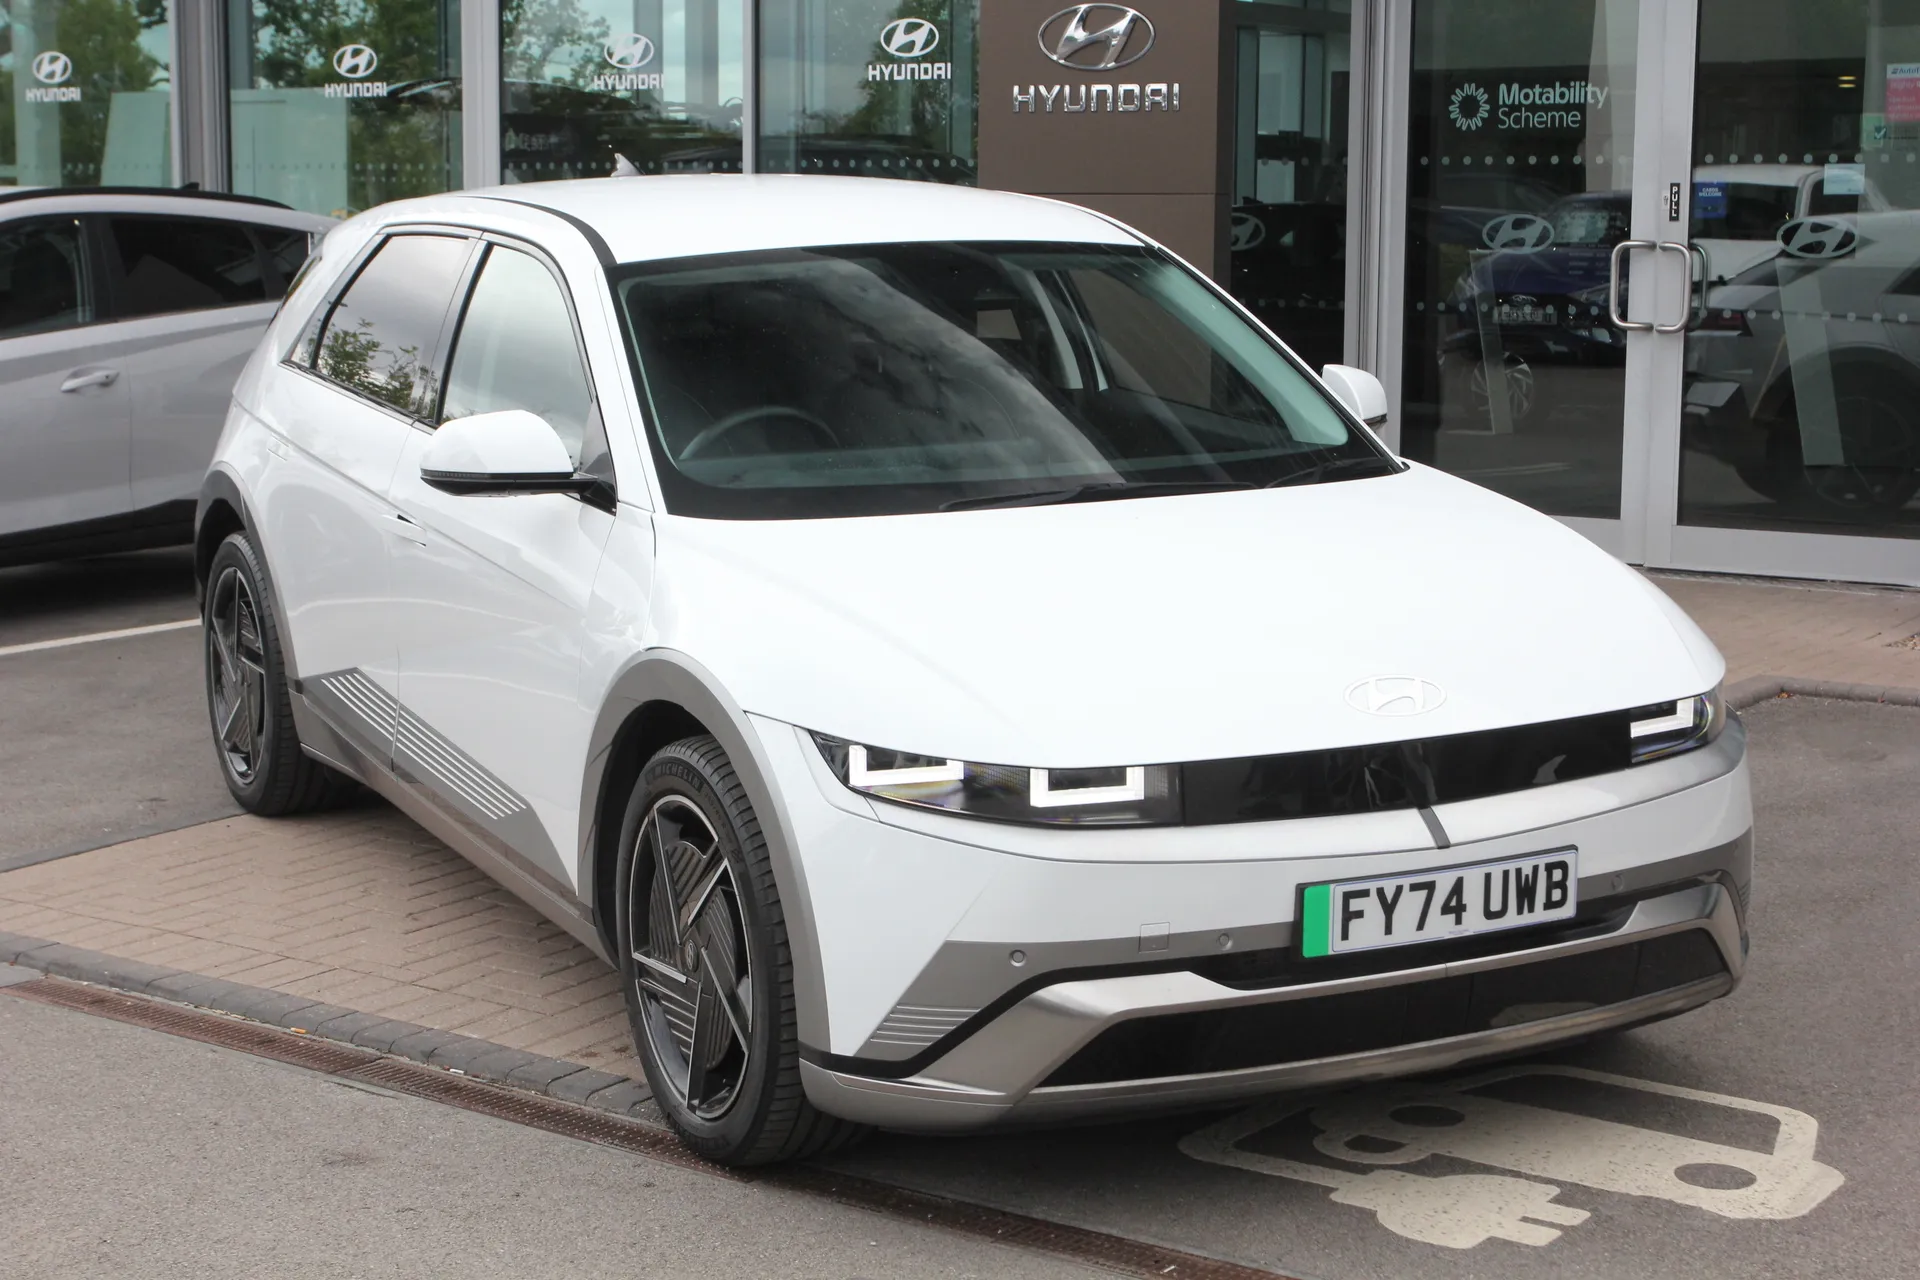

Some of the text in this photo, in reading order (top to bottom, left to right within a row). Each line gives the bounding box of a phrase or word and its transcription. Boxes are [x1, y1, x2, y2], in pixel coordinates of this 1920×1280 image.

[593, 73, 665, 90] HYUNDAI
[867, 62, 952, 81] HYUNDAI
[25, 87, 81, 102] HYUNDAI
[324, 81, 387, 98] HYUNDAI
[1012, 83, 1179, 112] HYUNDAI
[1499, 81, 1609, 109] Motability
[1498, 107, 1581, 129] Scheme
[654, 762, 701, 790] MICHELIN
[1341, 860, 1569, 942] FY74 UWB
